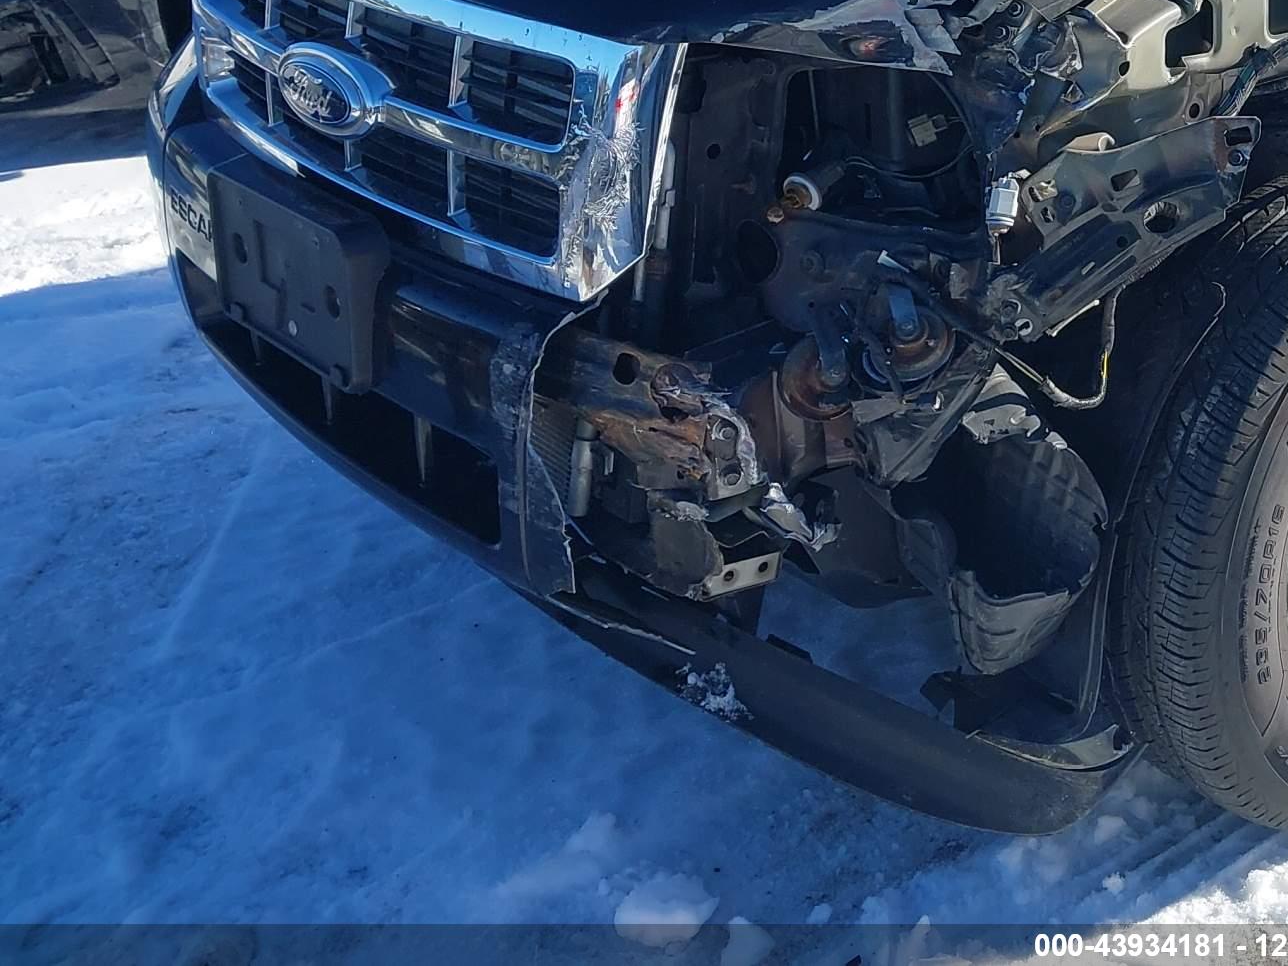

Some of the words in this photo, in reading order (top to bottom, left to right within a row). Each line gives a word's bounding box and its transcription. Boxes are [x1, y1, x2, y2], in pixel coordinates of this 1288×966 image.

[282, 65, 333, 119] Ford
[170, 186, 213, 243] ESCA
[1254, 503, 1286, 686] 235/70R16
